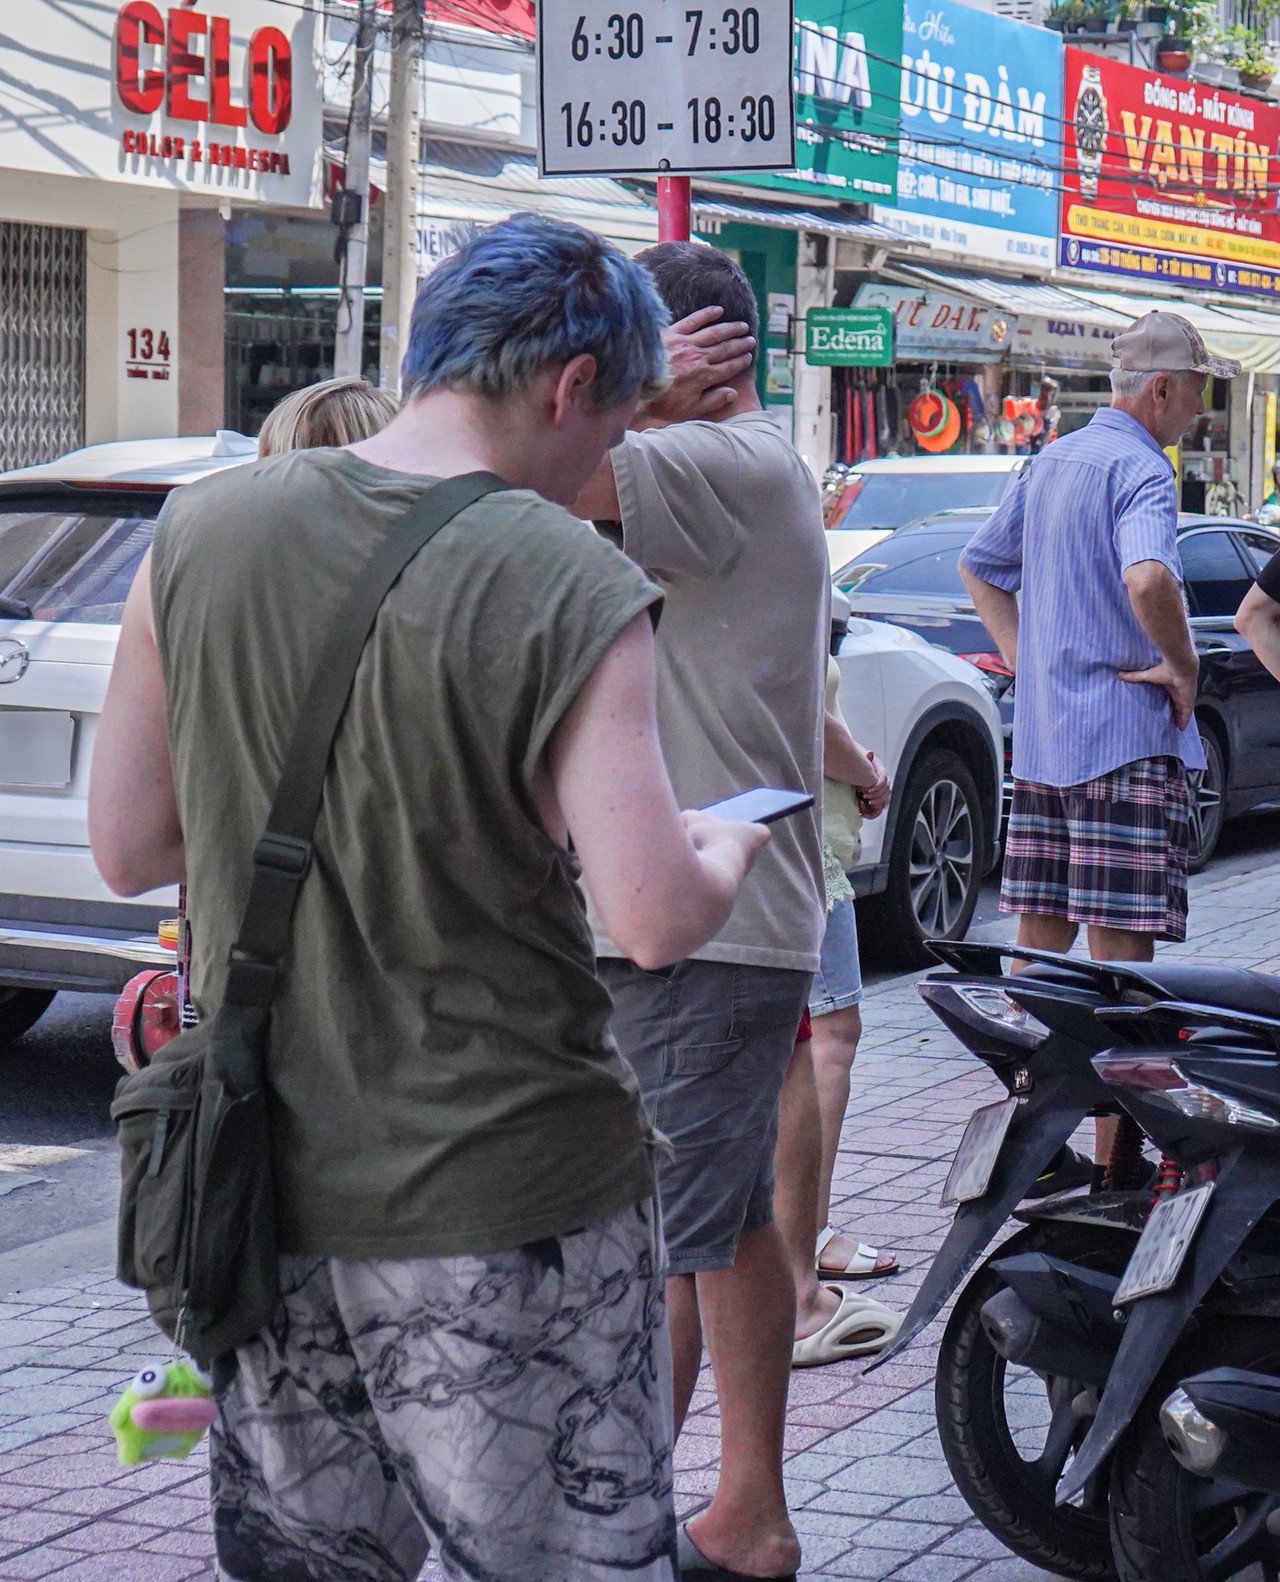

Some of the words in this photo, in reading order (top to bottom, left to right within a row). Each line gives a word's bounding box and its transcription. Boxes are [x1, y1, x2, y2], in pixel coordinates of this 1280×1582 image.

[571, 13, 643, 61] 6:30
[685, 7, 760, 56] 7:30
[561, 100, 646, 147] 16:30
[687, 94, 775, 144] 18:30
[963, 64, 1046, 147] ĐÀM
[1144, 78, 1177, 111] ĐỒNG
[1178, 87, 1196, 116] HỒ
[1203, 92, 1226, 124] MẮT
[1228, 102, 1254, 131] KÍNH
[123, 130, 185, 160] COLOR
[192, 140, 203, 163] &
[1120, 110, 1205, 188] VẠN
[1210, 130, 1270, 199] TÍN
[127, 328, 170, 361] 134
[810, 327, 884, 351] Edena
